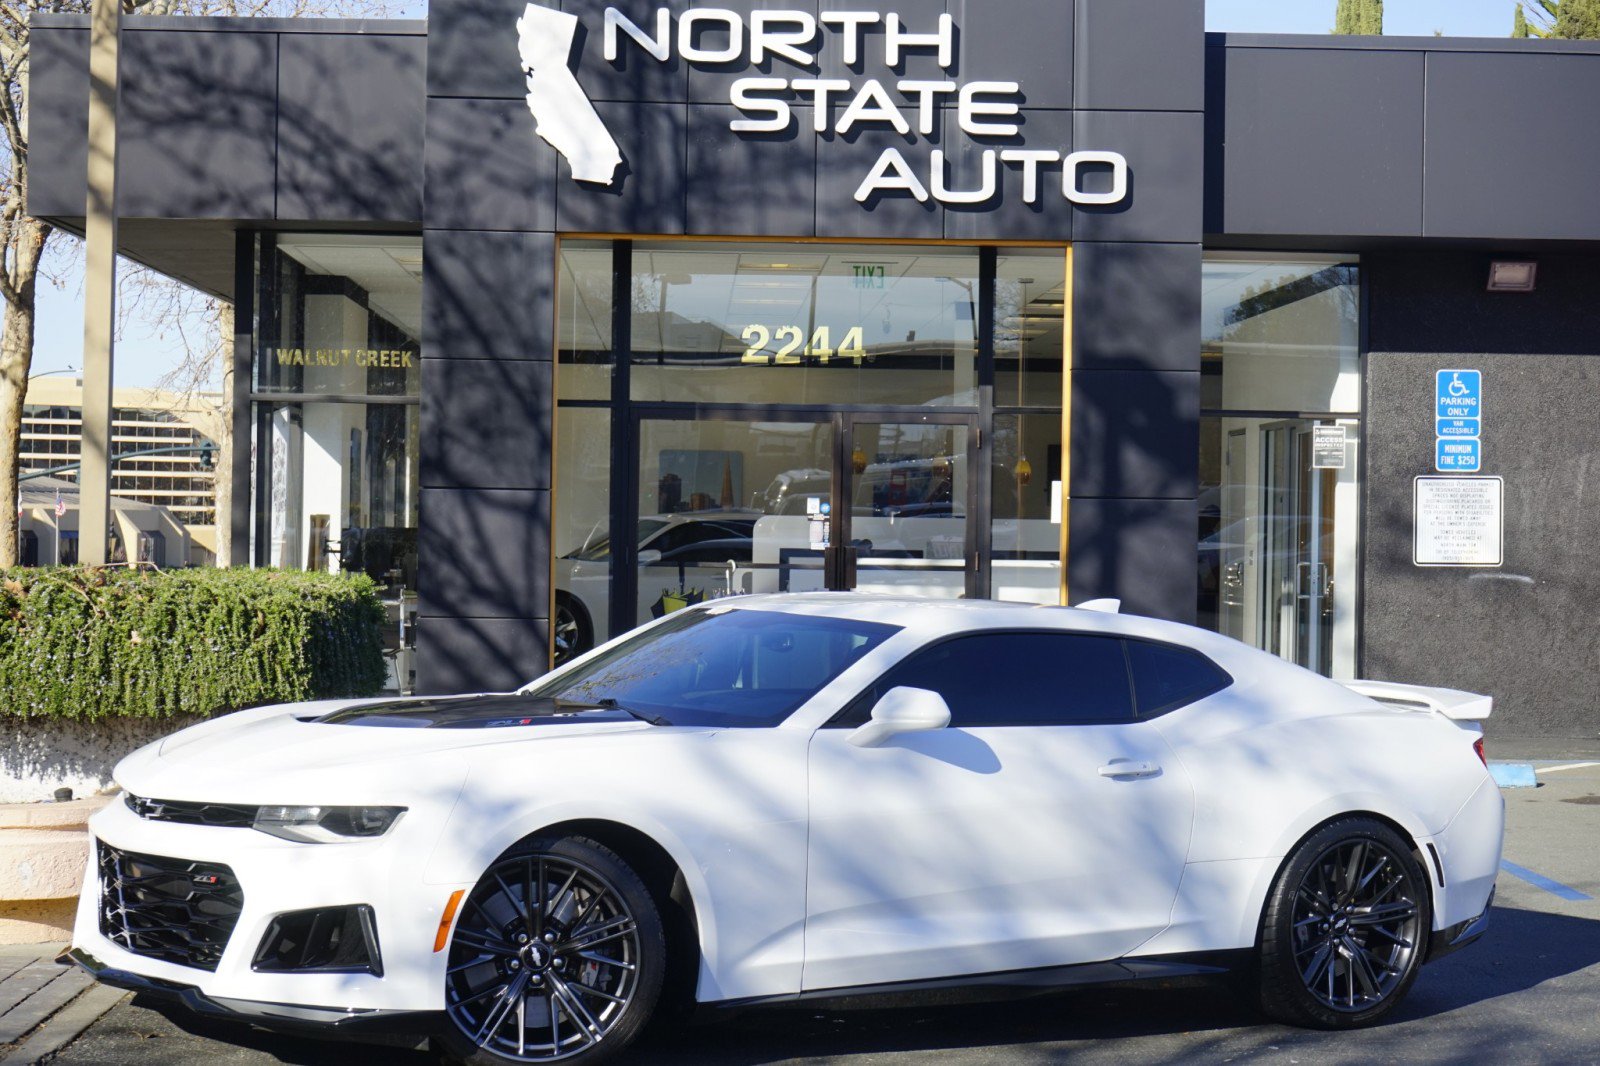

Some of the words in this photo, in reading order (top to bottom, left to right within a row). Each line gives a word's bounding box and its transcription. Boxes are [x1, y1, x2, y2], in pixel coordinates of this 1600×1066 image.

[604, 6, 953, 68] NORTH
[729, 77, 1019, 136] STATE
[853, 147, 1128, 205] AUTO
[741, 324, 867, 365] 2244
[276, 348, 351, 367] WALNUT
[355, 349, 412, 368] CREEK
[1440, 397, 1477, 406] PARKING
[1447, 407, 1470, 416] ONLY
[1444, 444, 1472, 454] MINIMUM
[1440, 455, 1455, 465] FINE
[1457, 455, 1476, 465] $250
